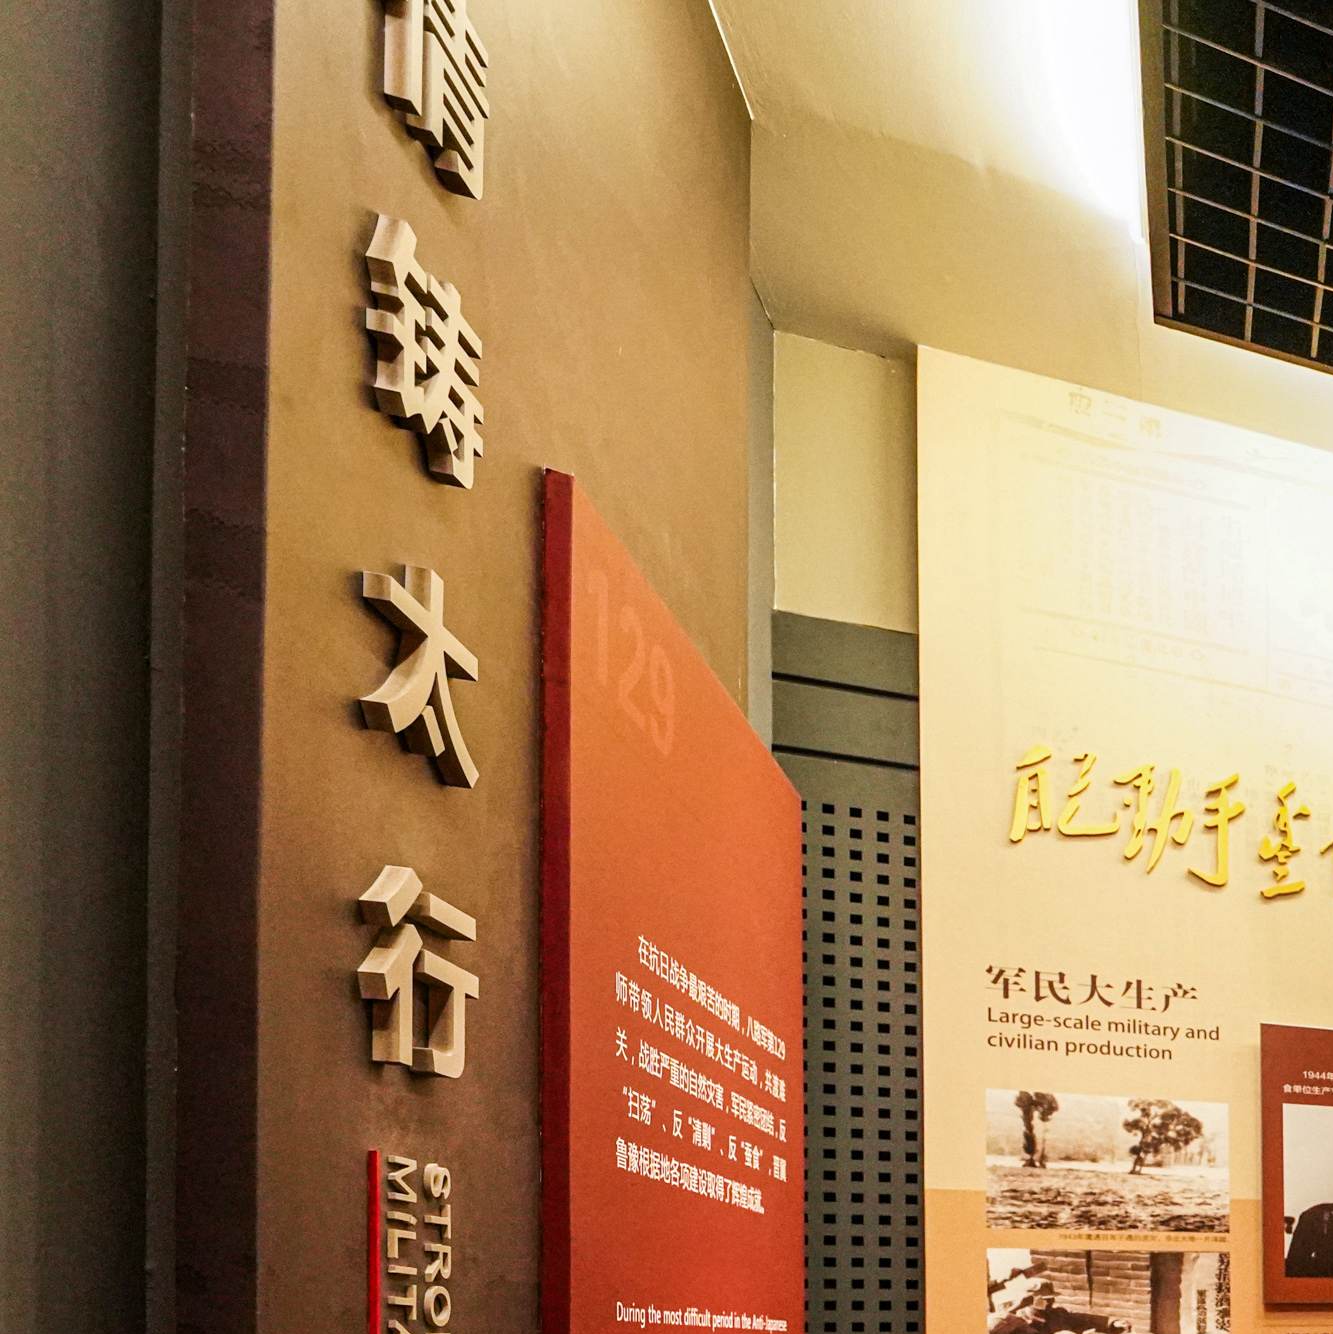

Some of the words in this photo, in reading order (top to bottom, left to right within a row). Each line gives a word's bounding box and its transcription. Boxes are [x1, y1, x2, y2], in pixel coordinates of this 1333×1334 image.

[587, 570, 675, 756] 129
[985, 964, 1198, 1013] 军民大生产
[987, 1007, 1101, 1032] Large-scale
[1107, 1018, 1180, 1041] military
[1185, 1026, 1220, 1041] and
[987, 1032, 1058, 1051] civilian
[1065, 1040, 1172, 1060] production
[616, 1301, 646, 1328] During
[648, 1304, 661, 1324] the
[663, 1308, 682, 1326] most
[684, 1307, 711, 1328] difficult
[712, 1311, 733, 1332] period
[734, 1312, 741, 1329] in
[741, 1313, 751, 1330] the
